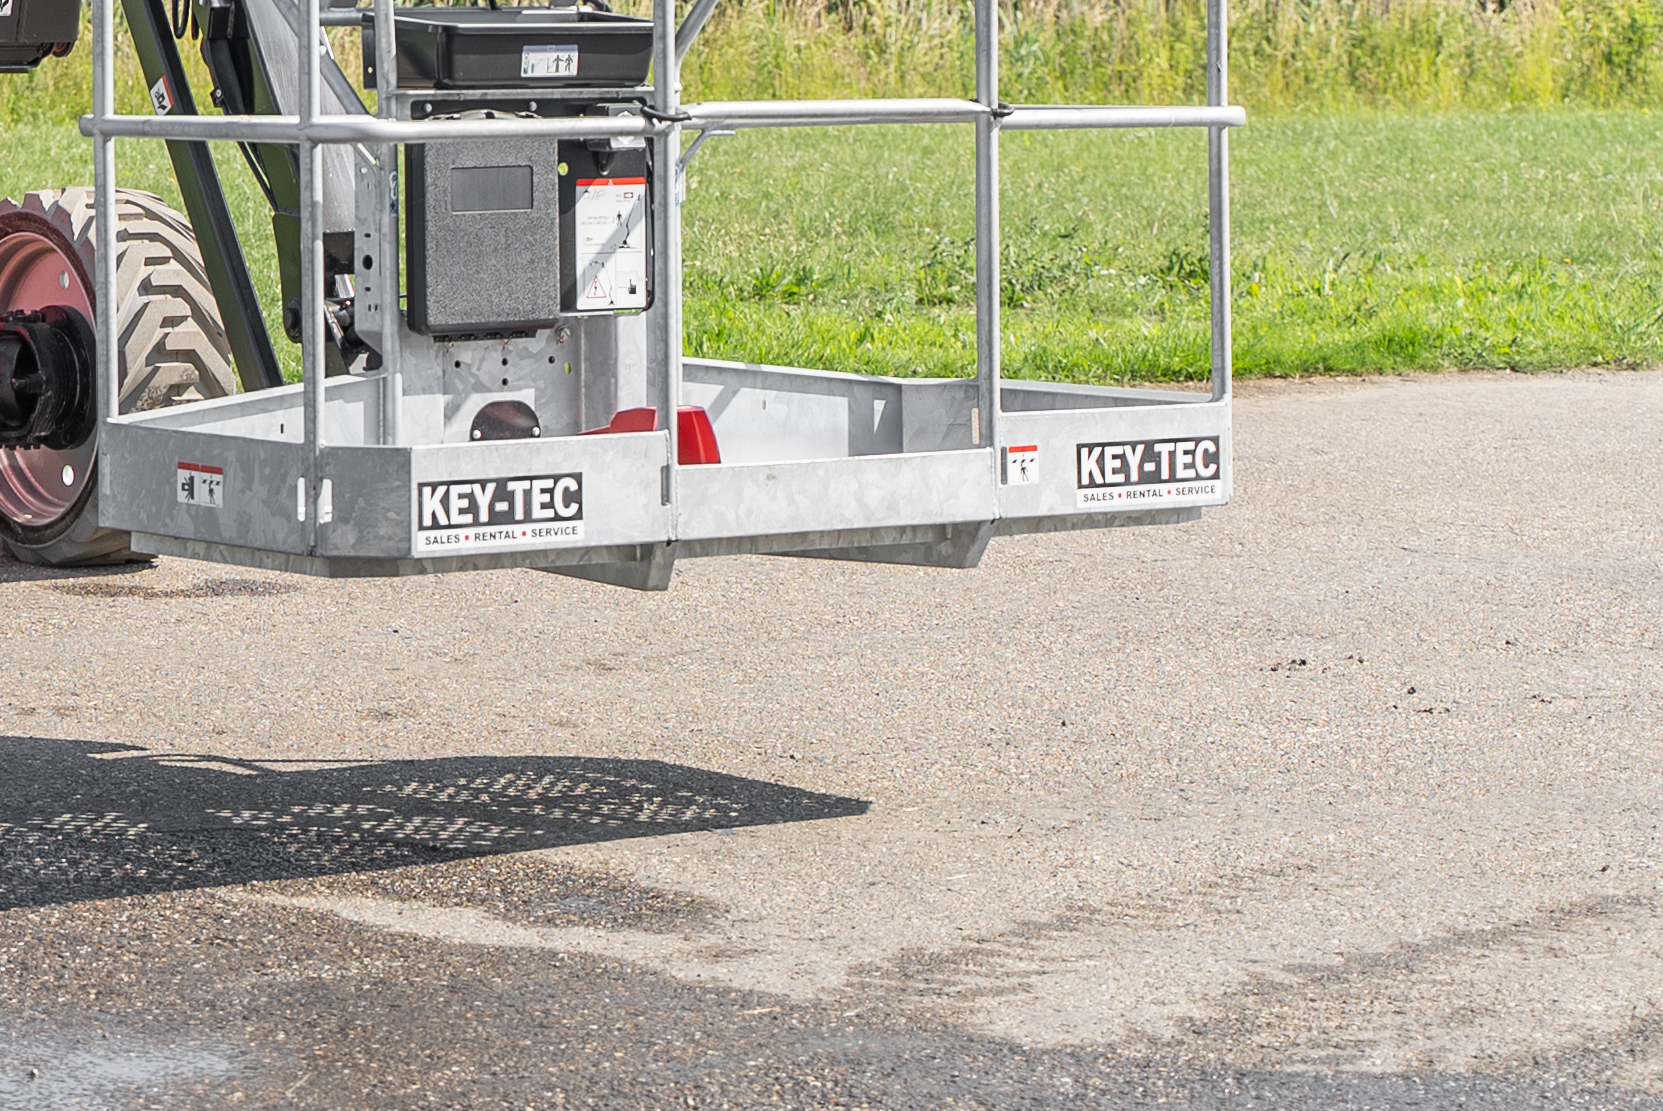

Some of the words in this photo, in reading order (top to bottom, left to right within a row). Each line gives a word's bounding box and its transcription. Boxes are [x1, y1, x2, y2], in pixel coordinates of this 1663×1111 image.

[1081, 439, 1217, 486] KEY-TEC
[422, 477, 579, 527] KEY-TEC
[1083, 492, 1114, 502] SALES
[1126, 489, 1163, 499] RENTAL
[1175, 485, 1216, 496] SERVICE
[425, 534, 460, 545] SALES
[474, 530, 518, 542] RENTAL
[531, 526, 578, 538] SERVICE
